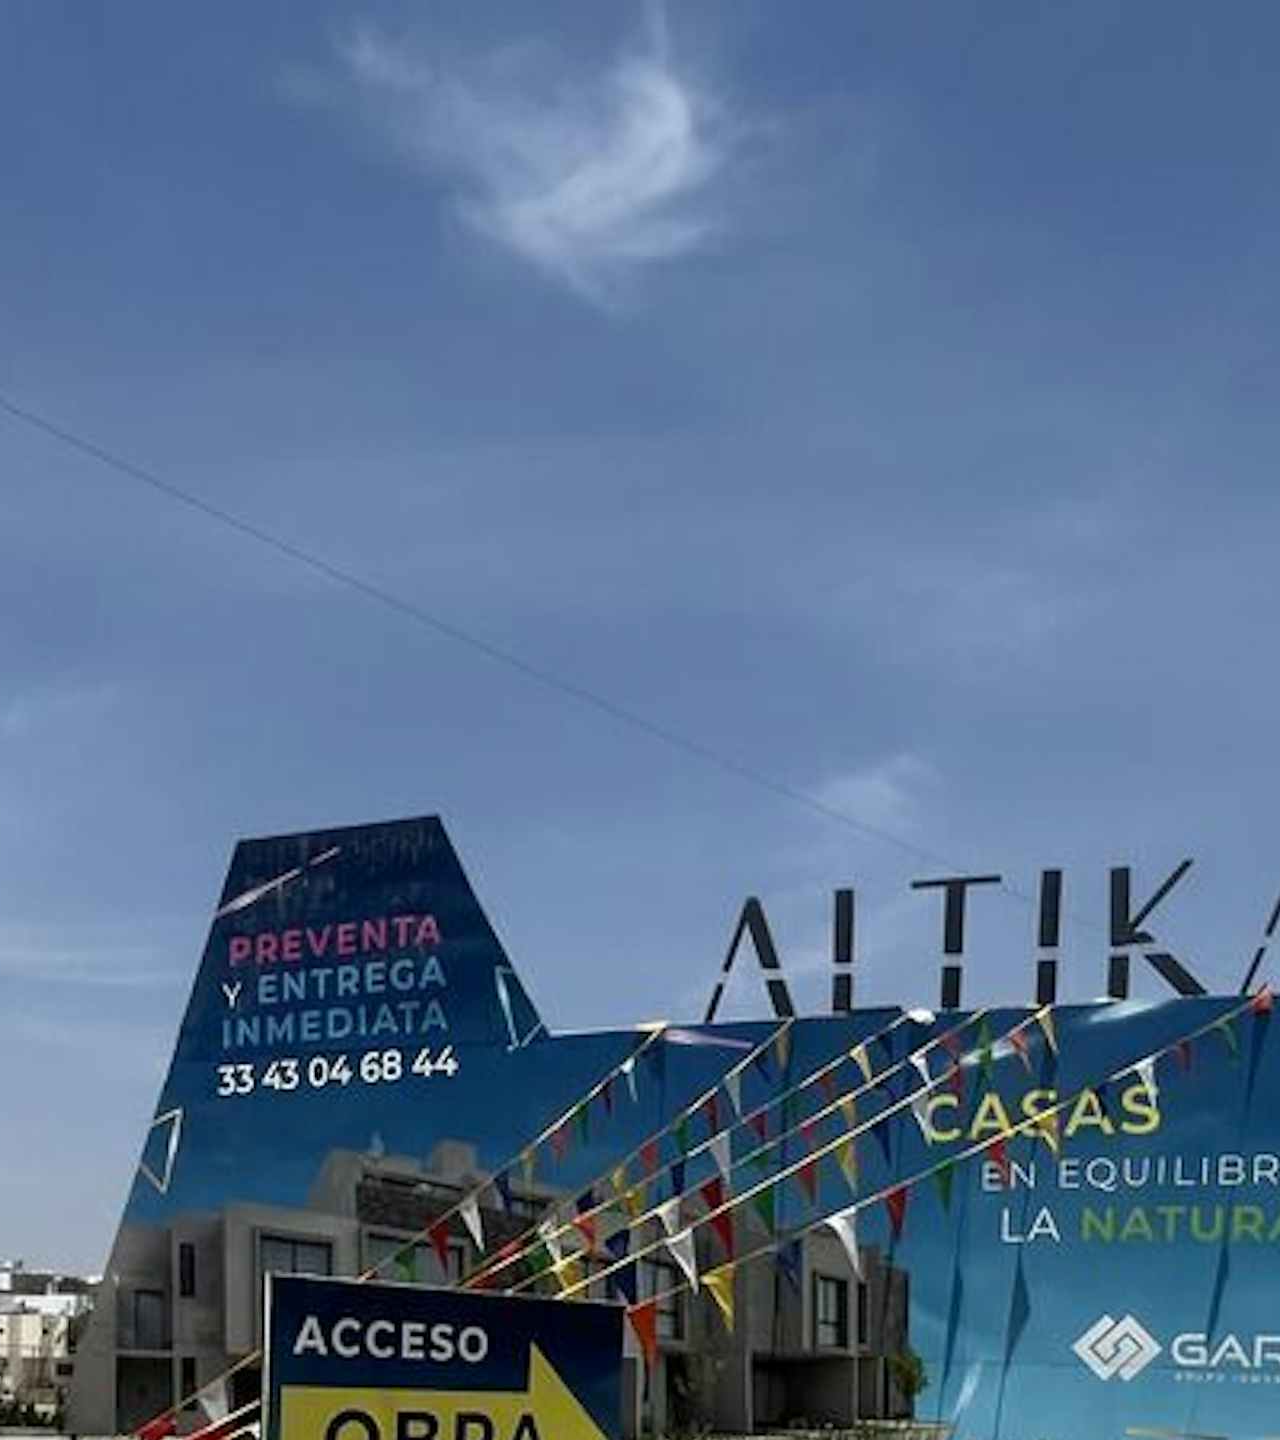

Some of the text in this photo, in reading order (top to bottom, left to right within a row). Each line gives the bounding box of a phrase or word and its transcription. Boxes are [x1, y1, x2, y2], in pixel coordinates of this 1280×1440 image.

[229, 914, 442, 967] PREVENTA
[222, 955, 448, 1008] Y ENTREGA
[222, 999, 449, 1049] INMEDIATA
[217, 1044, 460, 1097] 33 43 04 68 44
[923, 1083, 1163, 1143] CASAS
[981, 1158, 1037, 1192] EN
[1001, 1205, 1061, 1243] LA
[292, 1315, 490, 1364] ACCESO
